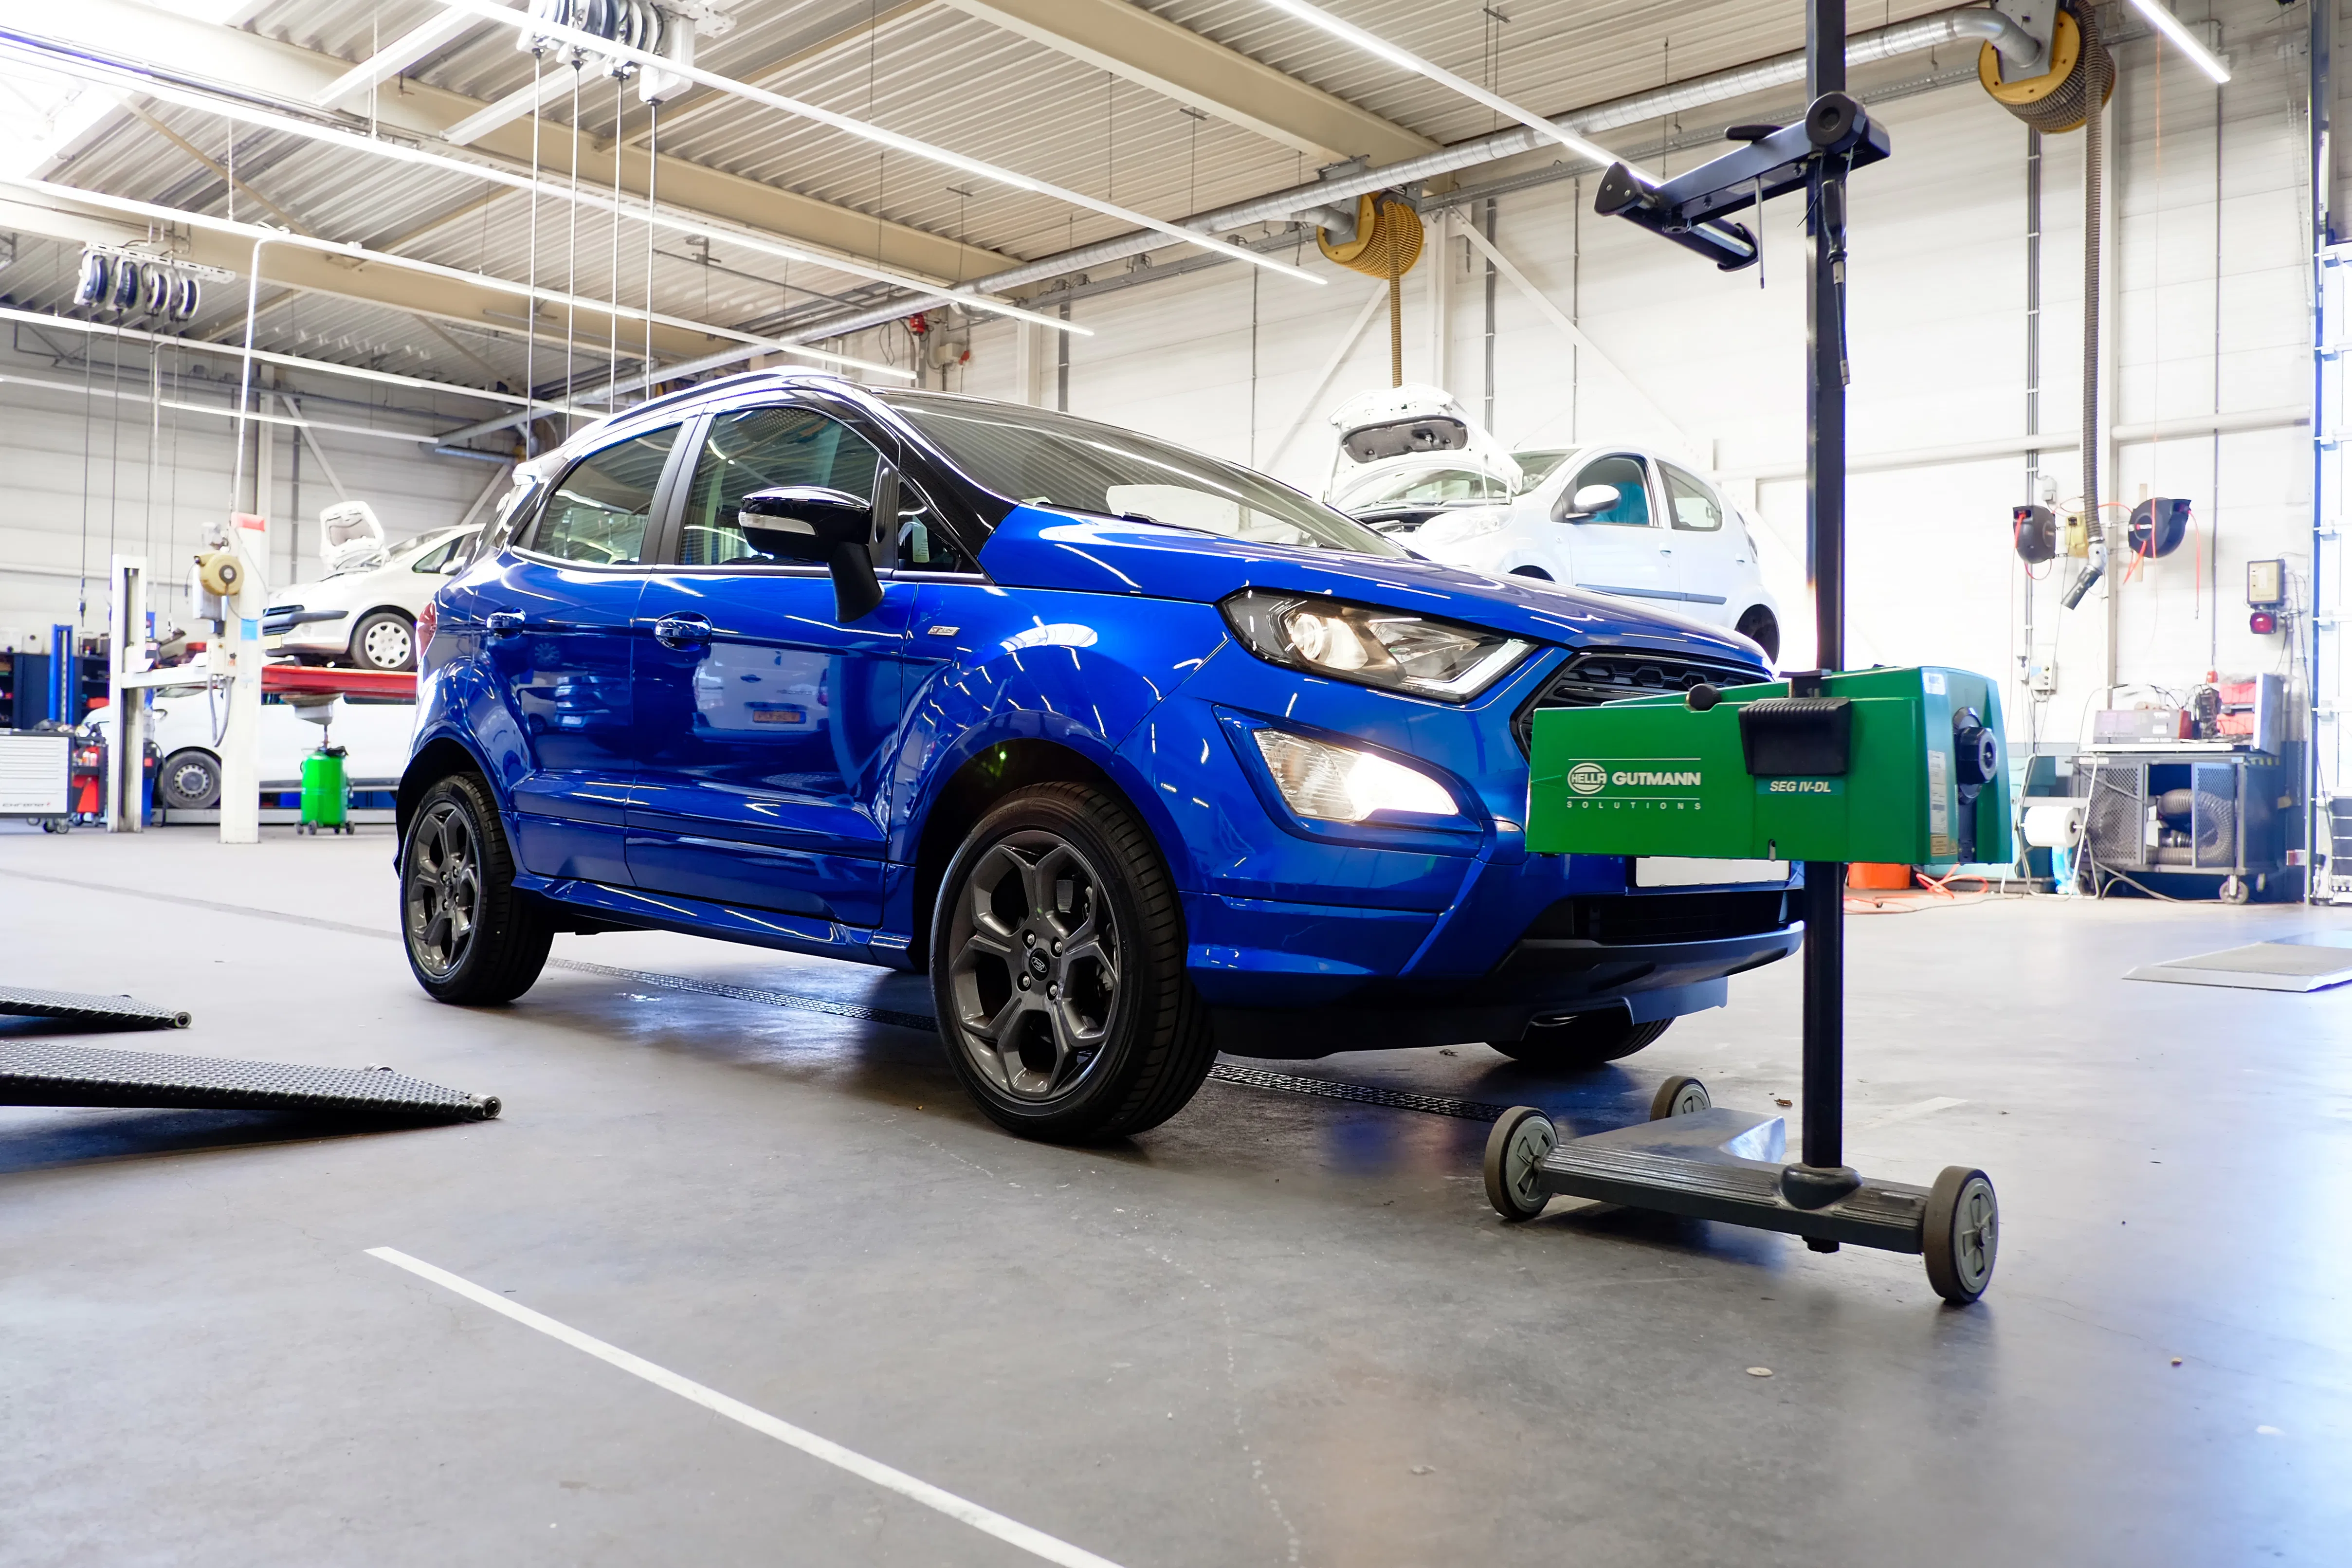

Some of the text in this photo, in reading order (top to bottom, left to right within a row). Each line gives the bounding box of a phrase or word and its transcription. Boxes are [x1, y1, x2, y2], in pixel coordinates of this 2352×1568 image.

[1571, 772, 1701, 785] HELLA GUTMANN
[1769, 781, 1832, 793] SEG IV-DL
[1567, 801, 1701, 810] SOLUTIONS
